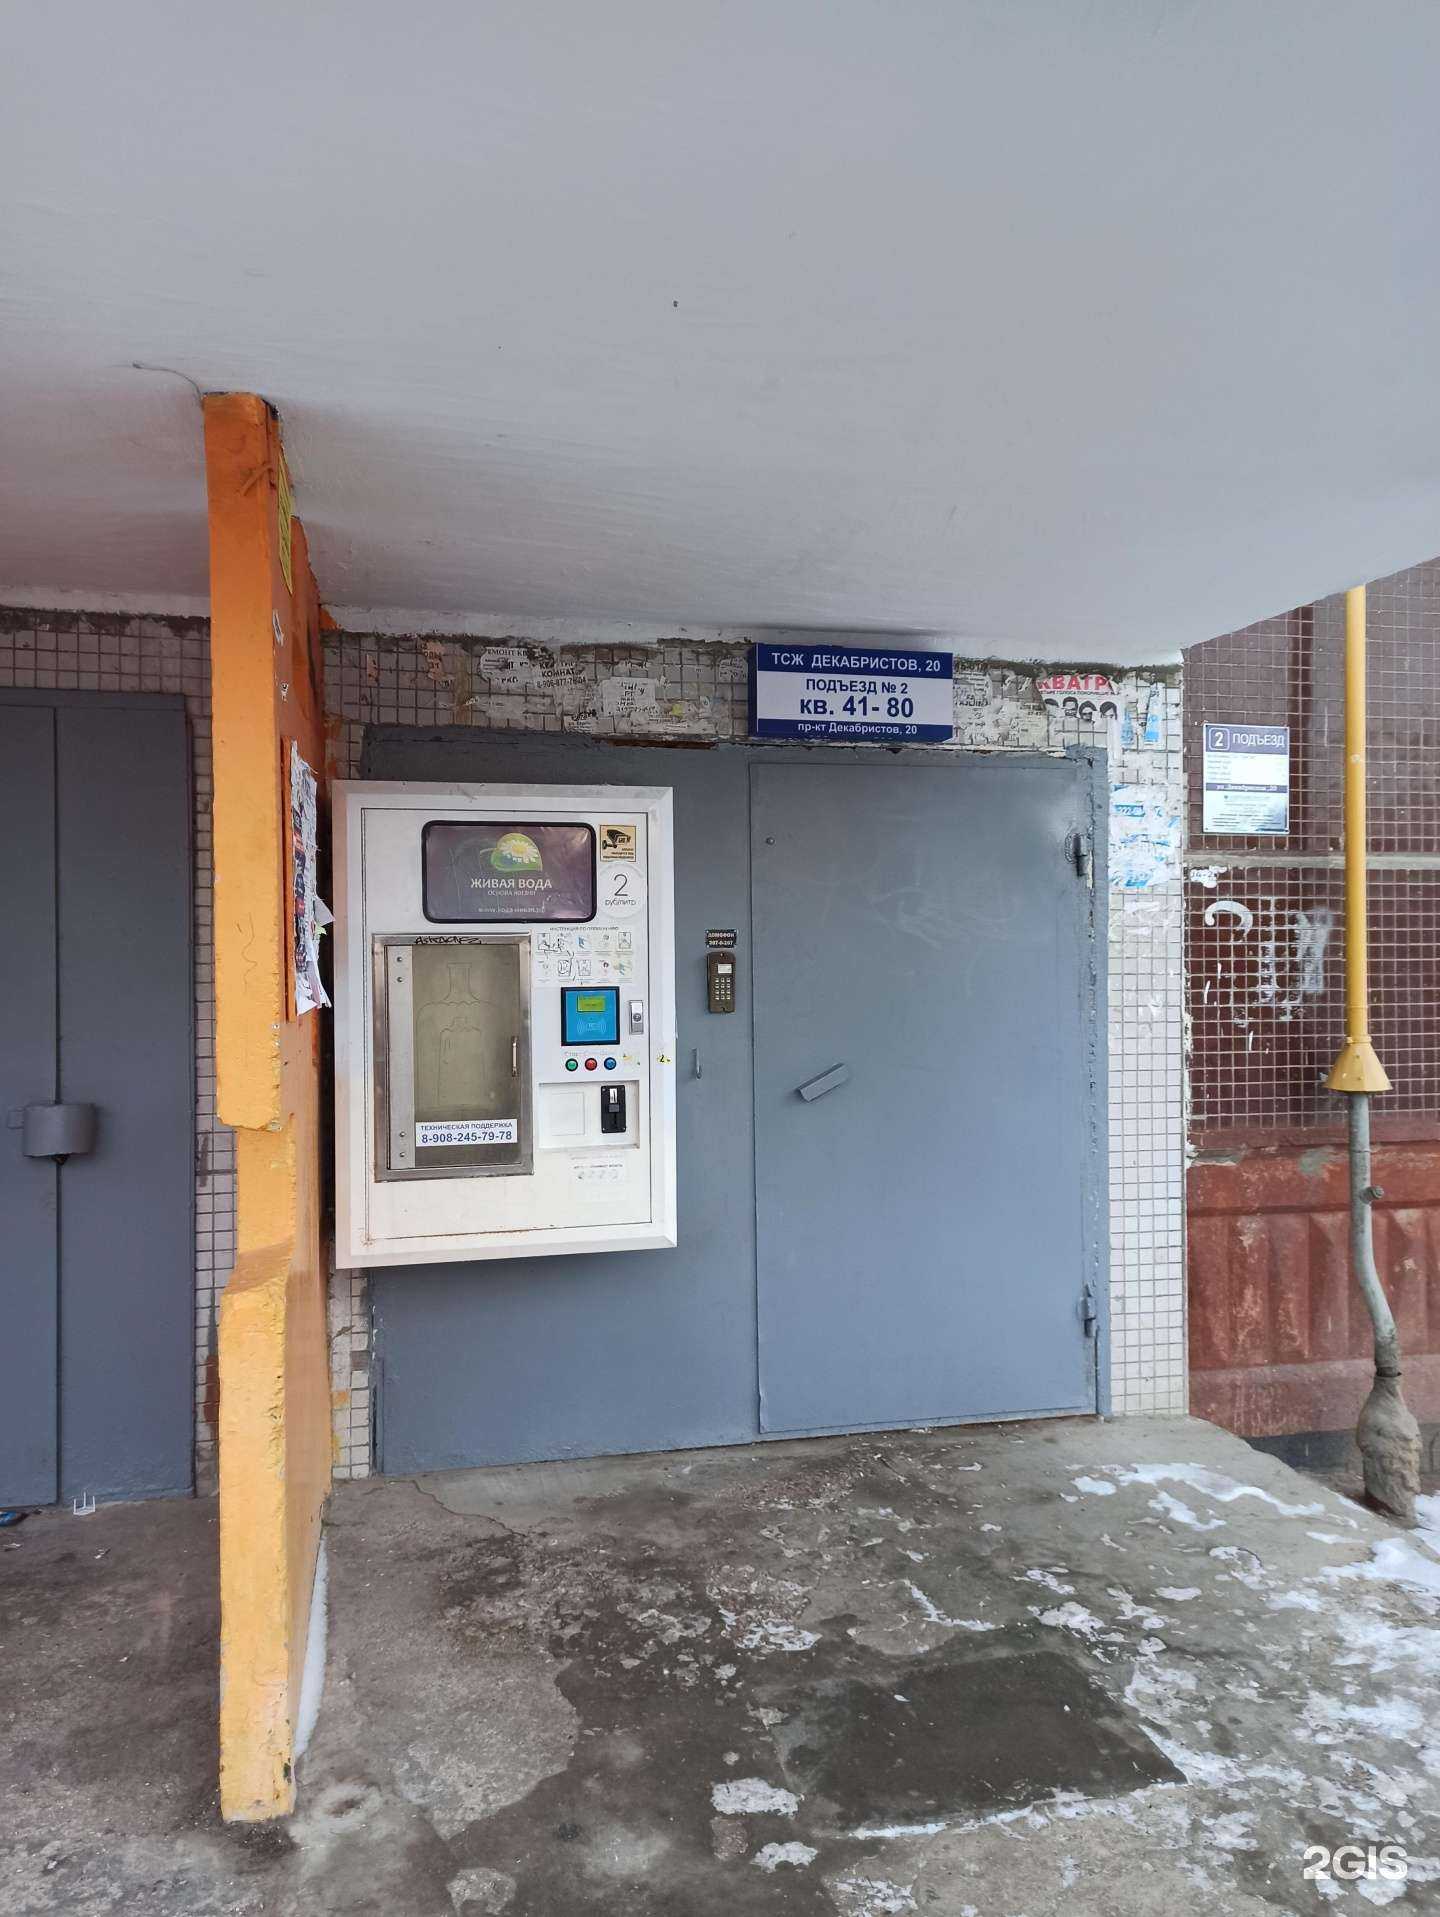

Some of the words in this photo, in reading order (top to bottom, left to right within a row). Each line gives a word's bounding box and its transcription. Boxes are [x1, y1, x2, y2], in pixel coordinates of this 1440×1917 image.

[771, 652, 805, 667] ТСЖ
[811, 654, 922, 673] ДЕКАБРИСТОВ,
[925, 659, 941, 672] 20
[806, 678, 878, 696] ПОДЪЕЗД
[881, 681, 897, 694] №
[900, 682, 908, 694] 2
[797, 723, 826, 735] пр-кт
[829, 722, 902, 736] Декабристов,
[905, 724, 918, 735] 20
[1214, 731, 1224, 747] 2
[1232, 733, 1286, 748] ПОДЪЕЗД
[470, 878, 515, 889] ЖИВАЯ
[518, 878, 553, 891] ВОДА
[613, 873, 629, 897] 2
[420, 1123, 470, 1131] ТЕХНИЧЕСКАЯ
[470, 1122, 513, 1130] ПОДДЕРЖКА
[421, 1130, 513, 1144] 8-908-245-79-78
